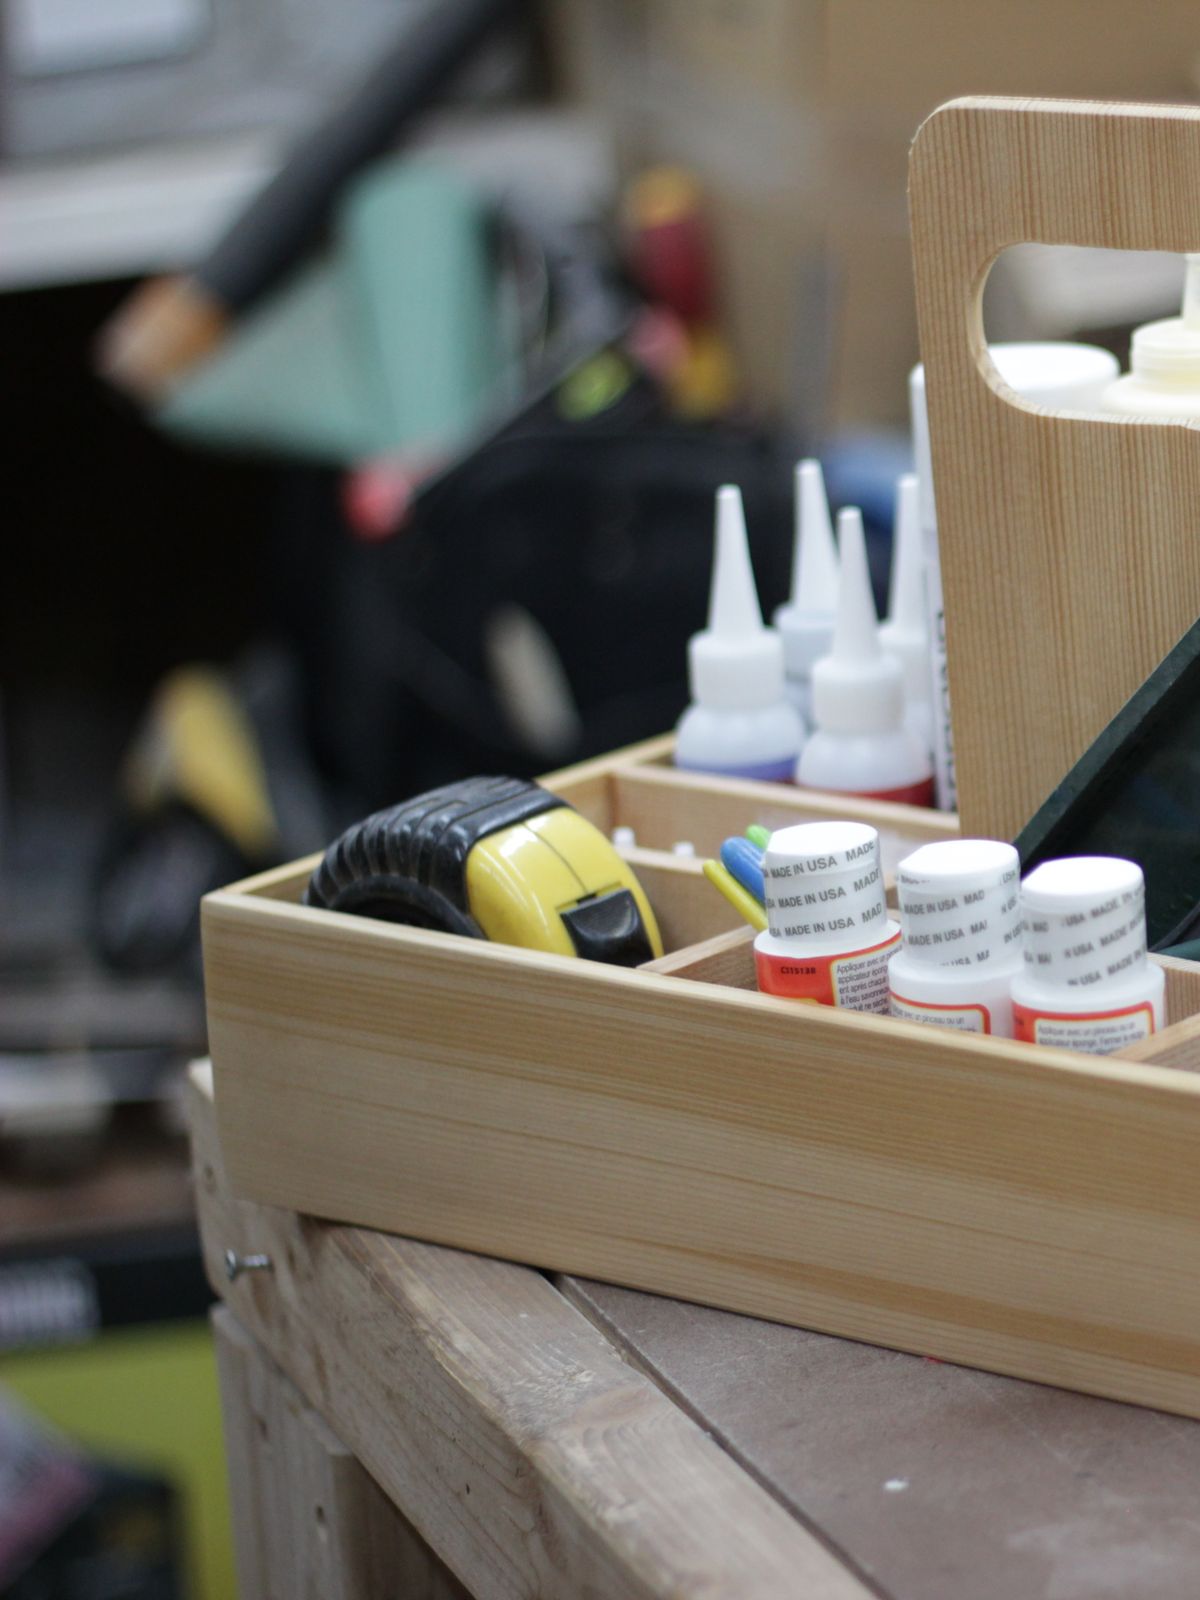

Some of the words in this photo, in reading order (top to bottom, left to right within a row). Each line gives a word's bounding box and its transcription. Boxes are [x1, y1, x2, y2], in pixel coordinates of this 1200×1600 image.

[770, 865, 792, 878] MADE
[793, 863, 804, 875] IN
[807, 856, 838, 872] USA
[778, 896, 803, 908] MADE
[804, 894, 817, 905] IN
[818, 886, 847, 902] USA
[903, 903, 925, 915] MADE
[926, 903, 936, 914] IN
[937, 898, 958, 912] USA
[1065, 912, 1086, 927] USA
[1090, 899, 1119, 919] MADE
[785, 924, 811, 937] MADE
[813, 922, 826, 933] IN
[828, 917, 855, 931] USA
[908, 934, 932, 945] MADE
[933, 933, 943, 944] IN
[944, 928, 965, 942] USA
[1072, 942, 1094, 957] USA
[1100, 926, 1127, 947] MADE
[837, 961, 865, 974] Appliquer
[838, 971, 871, 984] applicateur
[1080, 970, 1102, 985] USA
[1107, 954, 1132, 976] MADE
[851, 983, 868, 992] après
